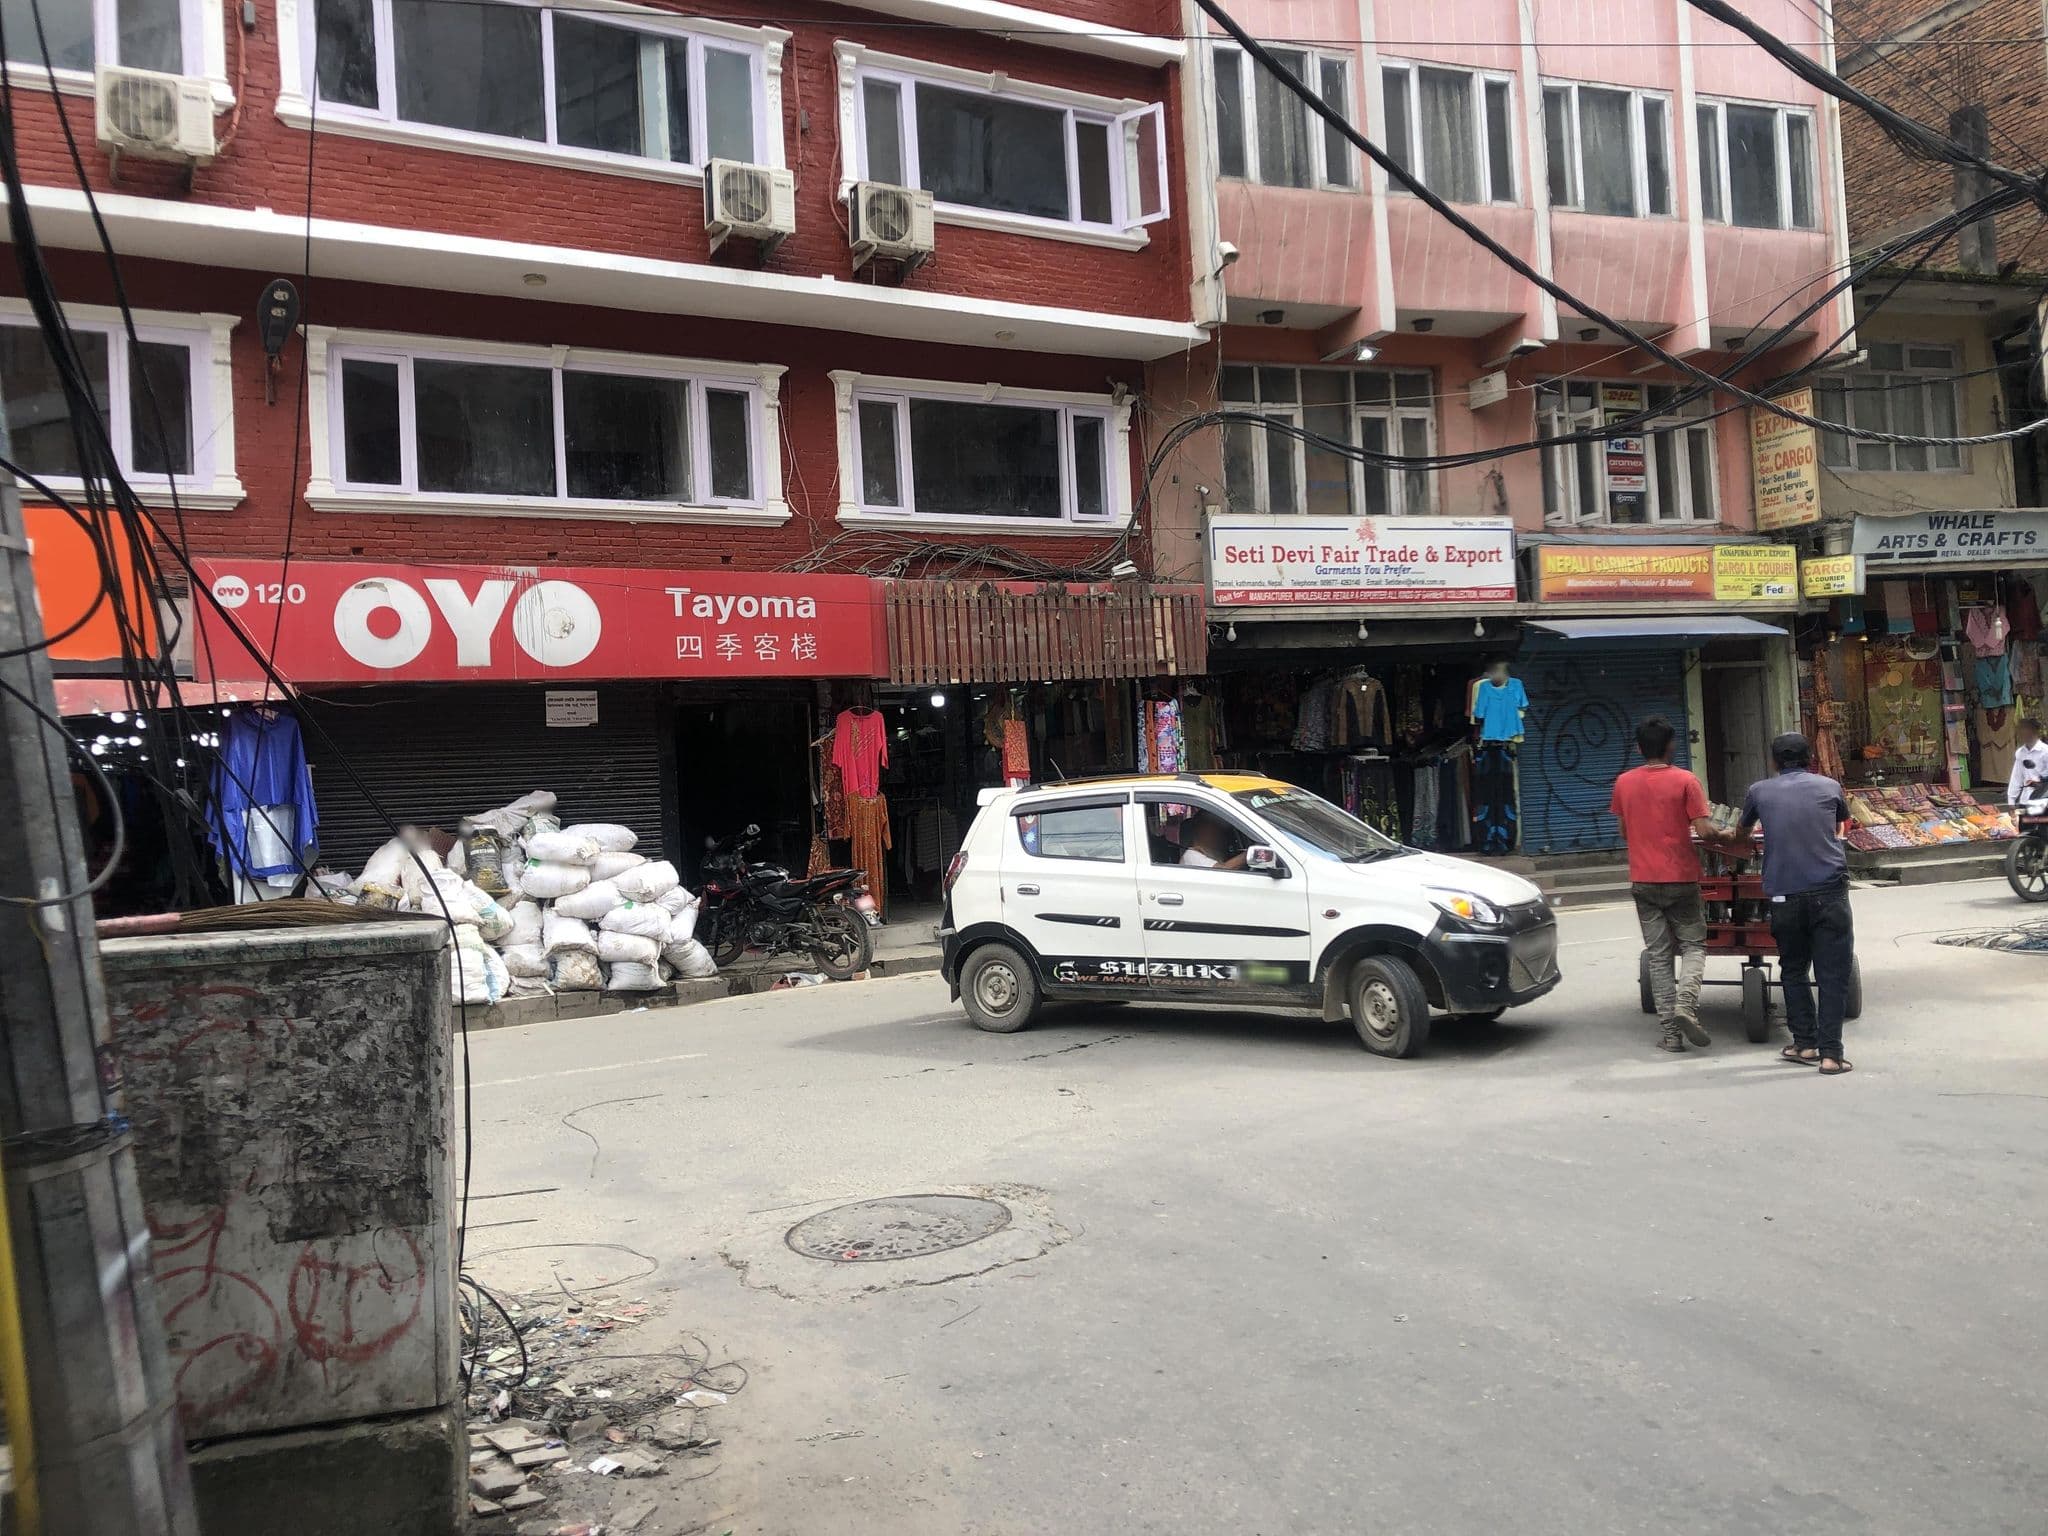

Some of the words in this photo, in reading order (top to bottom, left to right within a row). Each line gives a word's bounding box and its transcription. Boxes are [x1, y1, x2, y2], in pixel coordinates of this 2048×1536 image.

[1608, 440, 1641, 452] FedEx
[1609, 459, 1644, 468] aramex
[1774, 445, 1813, 471] CARGO
[1762, 485, 1782, 497] Parcel
[1783, 480, 1809, 491] Service
[1928, 514, 1996, 530] WHALE
[1877, 533, 1929, 549] ARTS
[1935, 533, 1948, 548] &
[1957, 530, 2038, 547] CRAFTS
[1225, 545, 1265, 564] Seti
[1272, 545, 1315, 564] Devi
[1321, 545, 1360, 563] Fair
[1366, 545, 1419, 563] Trade
[1425, 545, 1439, 563] &
[1445, 545, 1503, 567] Export
[1768, 550, 1790, 558] EXPORT
[1941, 549, 1962, 557] RETAIL
[1967, 549, 1991, 557] DEALER
[1315, 565, 1361, 575] Garments
[1364, 565, 1380, 575] You
[1547, 555, 1591, 573] NEPALI
[1593, 555, 1649, 573] GARMENT
[1652, 555, 1710, 574] PRODUCTS
[1717, 560, 1747, 576] CARGO
[1749, 560, 1756, 576] &
[1758, 560, 1794, 576] COURIER
[1803, 562, 1852, 576] CARGO
[1815, 574, 1846, 583] COURIER
[217, 587, 245, 597] OYO
[254, 583, 306, 604] 120
[1217, 593, 1233, 602] Visit
[665, 587, 817, 625] Tayoma
[333, 577, 602, 669] OYO
[1103, 975, 1148, 984] MAKE
